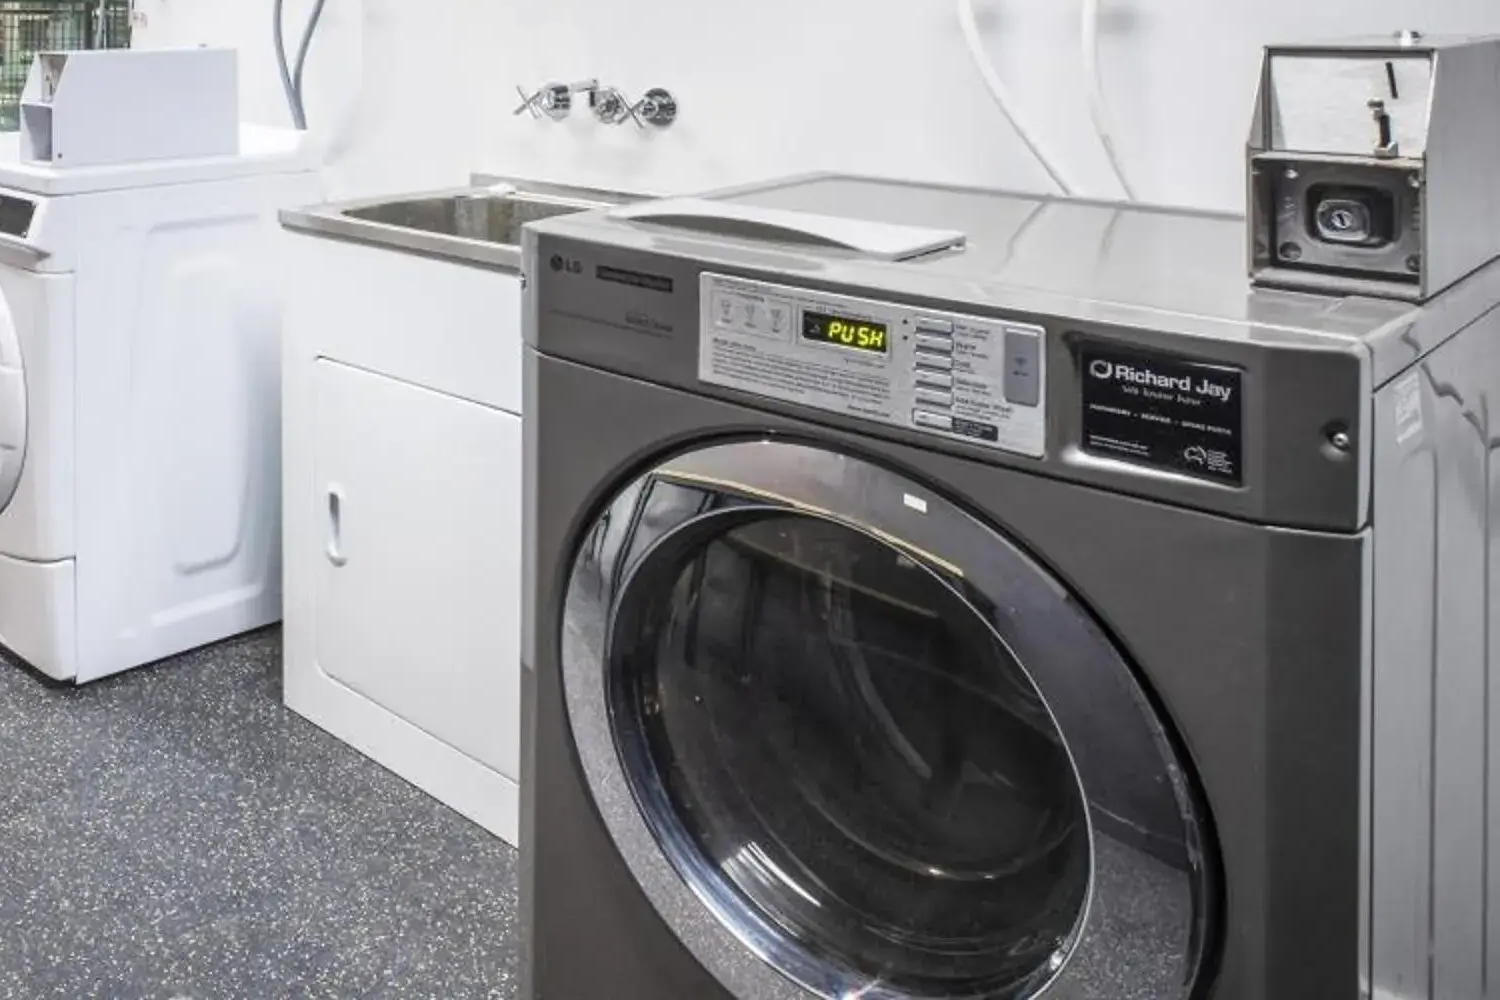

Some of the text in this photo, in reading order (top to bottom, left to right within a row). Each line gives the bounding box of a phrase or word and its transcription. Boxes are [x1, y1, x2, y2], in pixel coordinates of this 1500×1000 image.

[827, 321, 884, 348] PUSH
[1114, 364, 1232, 402] Richard Jay
